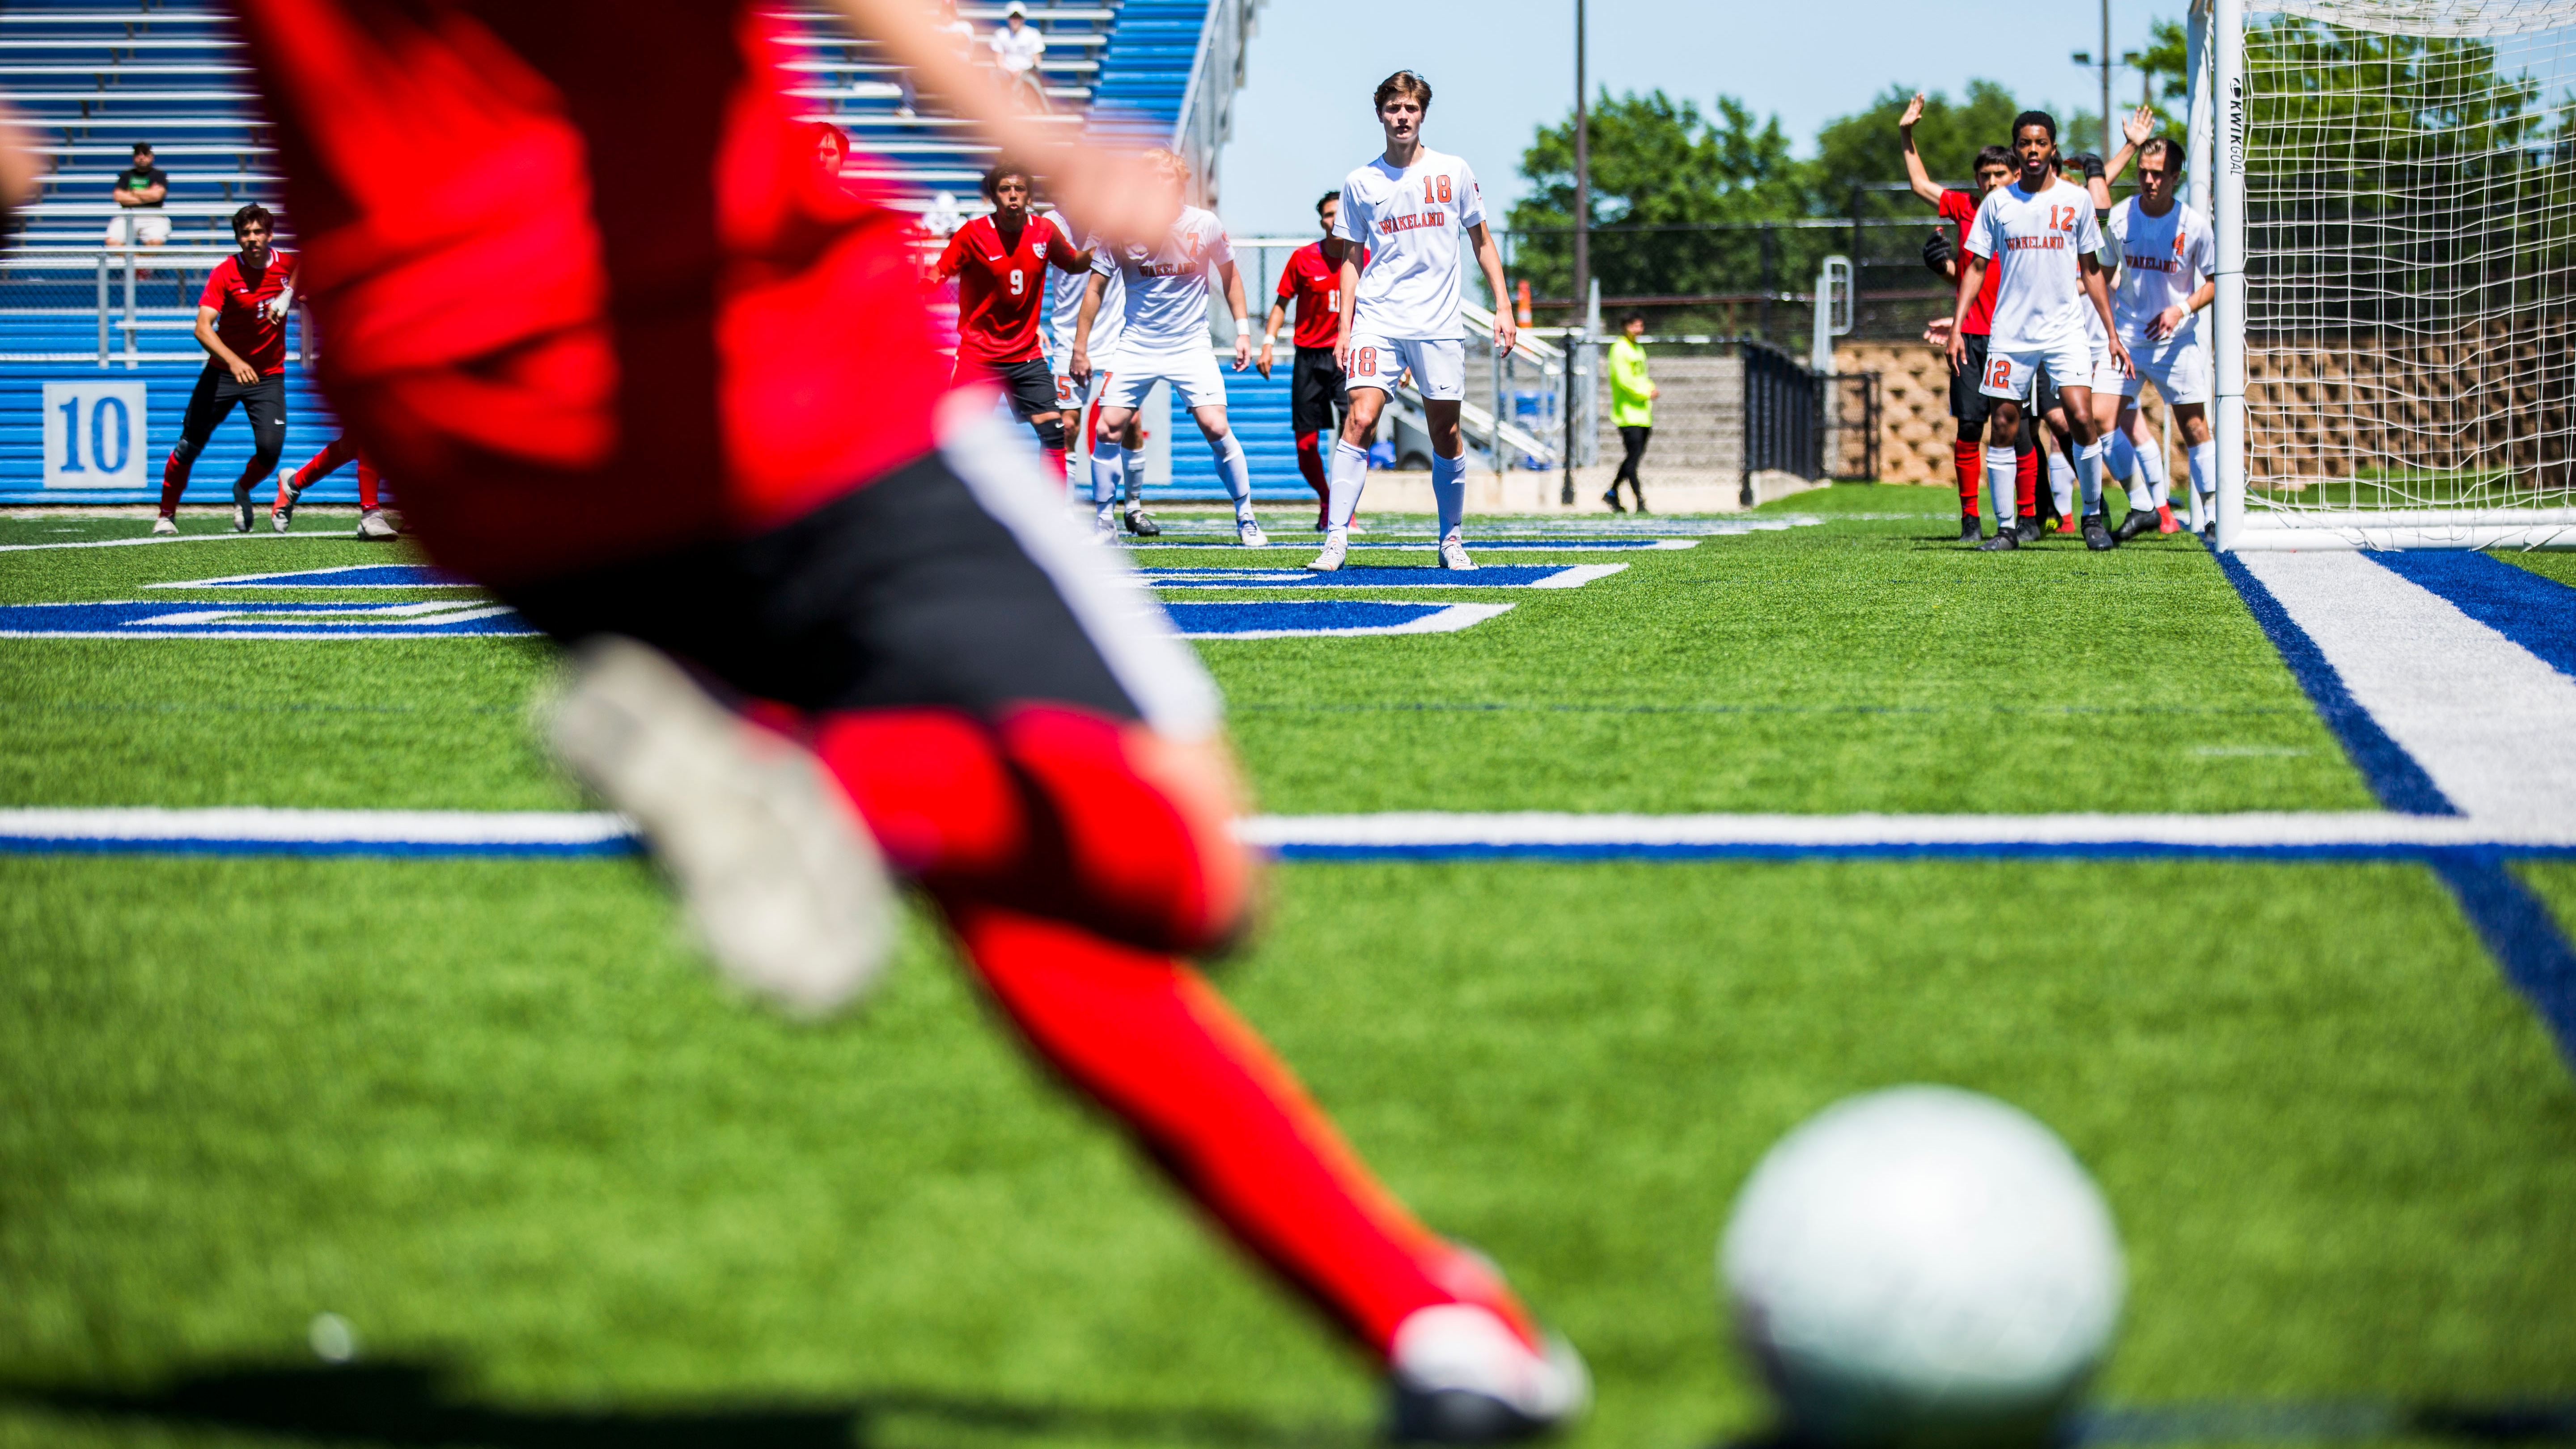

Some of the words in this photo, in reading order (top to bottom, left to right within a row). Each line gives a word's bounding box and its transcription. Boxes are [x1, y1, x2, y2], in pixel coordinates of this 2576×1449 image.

[2230, 100, 2241, 176] KWIKGOAL
[1424, 175, 1452, 203] 18
[1379, 212, 1445, 235] WAKELAND
[2049, 204, 2075, 232] 12
[1187, 233, 1199, 257] 7
[2005, 236, 2064, 251] WAKELAND
[2172, 232, 2185, 256] 4
[1138, 262, 1196, 277] WAKELAND
[2125, 255, 2177, 274] WAKELAND
[1010, 269, 1023, 295] 9
[1348, 347, 1377, 379] 18
[1984, 358, 2011, 389] 12
[1100, 372, 1113, 396] 7
[59, 396, 130, 475] 10
